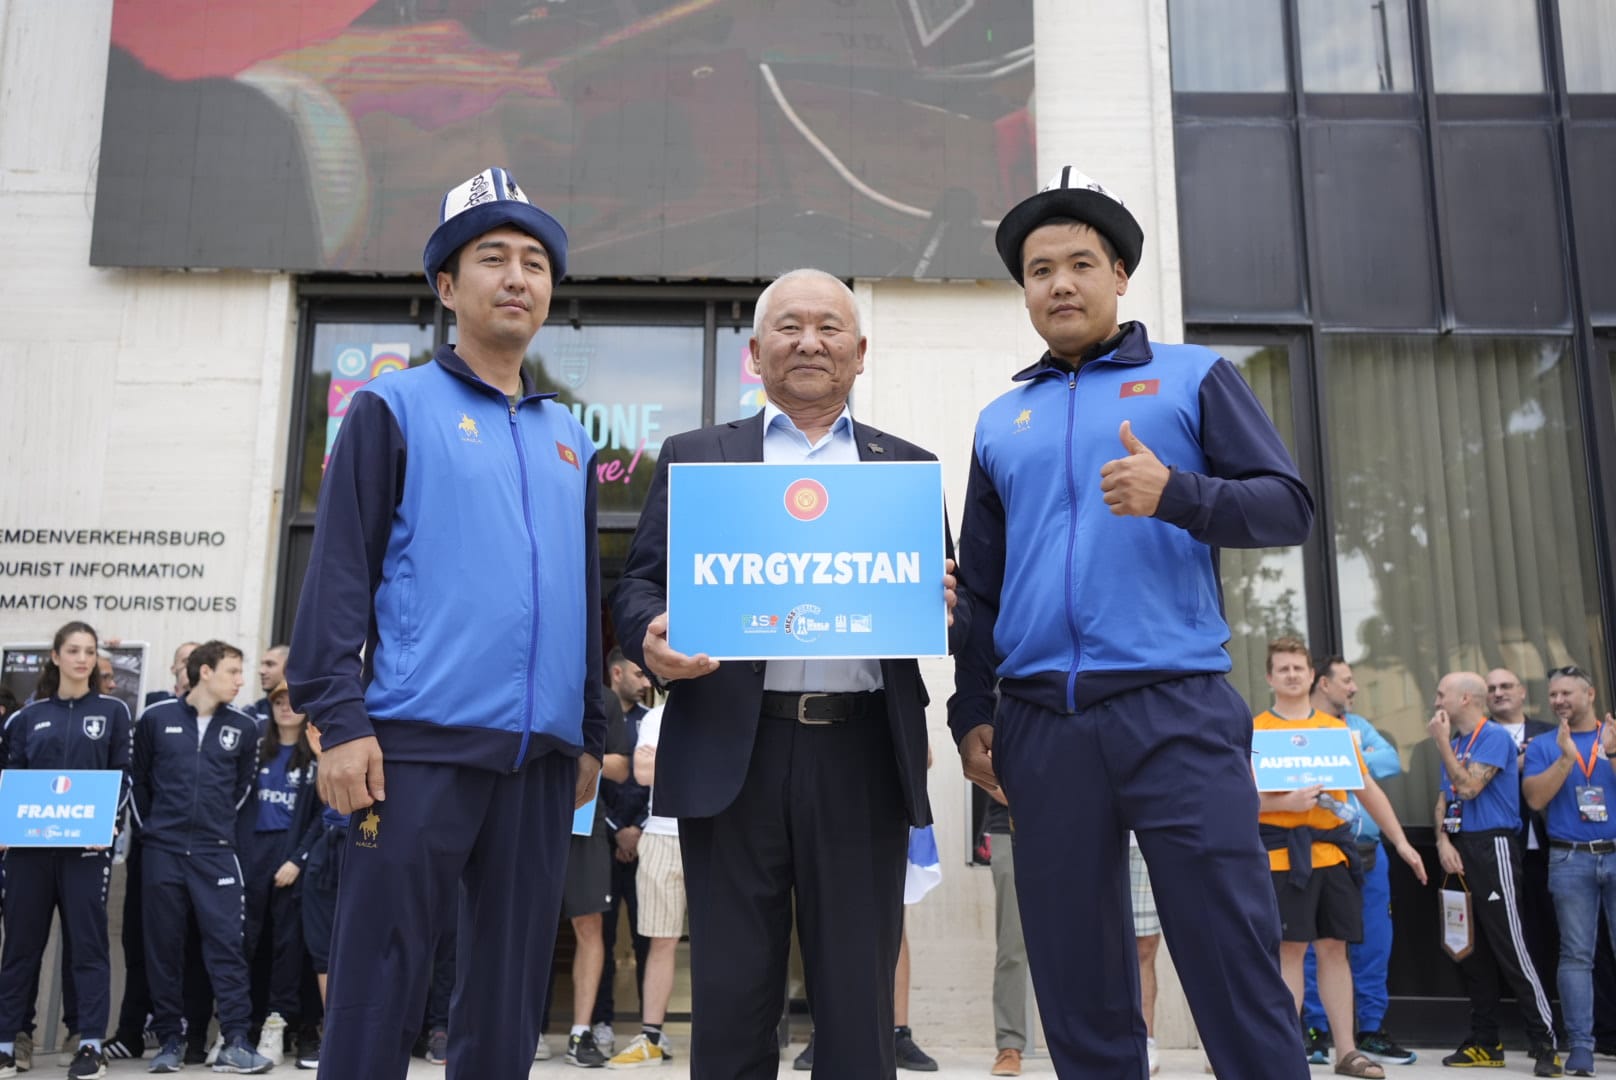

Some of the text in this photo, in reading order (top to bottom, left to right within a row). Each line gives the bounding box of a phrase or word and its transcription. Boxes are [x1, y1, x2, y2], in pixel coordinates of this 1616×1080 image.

[69, 562, 204, 578] INFORMATION
[694, 552, 920, 585] KYRGYZSTAN
[93, 595, 237, 612] TOURISTIQUES
[1259, 755, 1352, 769] AUSTRALIA
[16, 804, 95, 819] FRANCE
